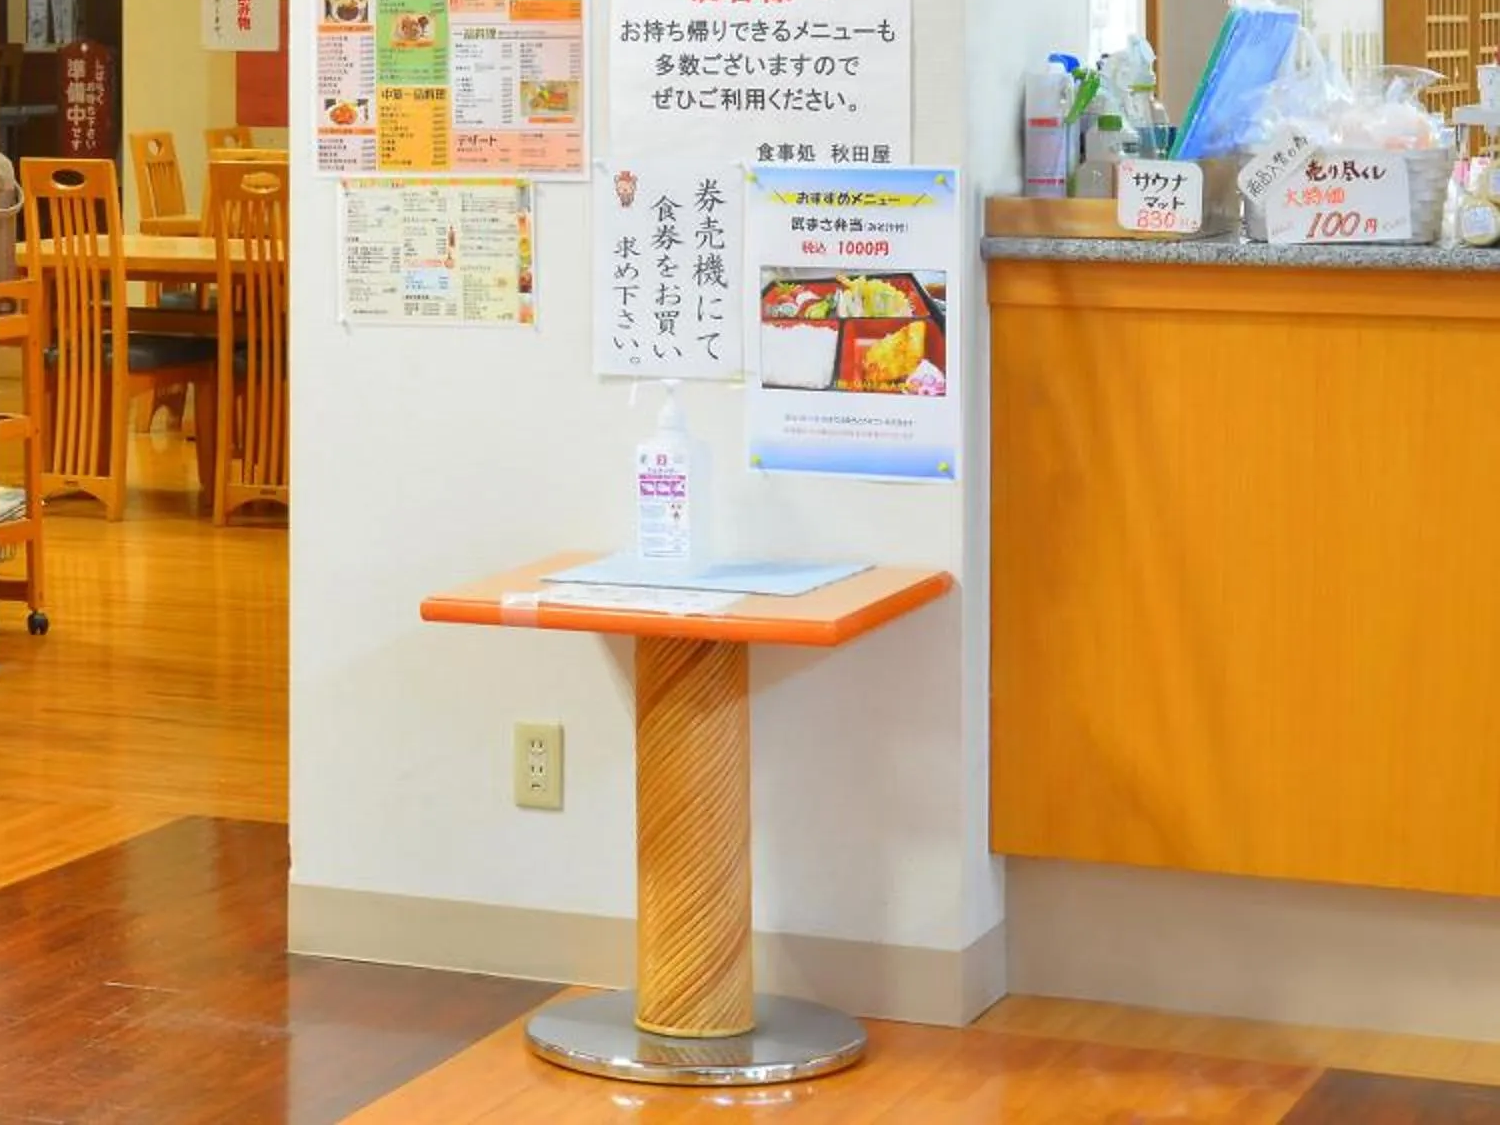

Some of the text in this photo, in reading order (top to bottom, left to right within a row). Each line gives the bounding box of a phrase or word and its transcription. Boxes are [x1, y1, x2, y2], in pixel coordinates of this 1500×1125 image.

[620, 19, 896, 43] お持ち帰りできるメニューも
[655, 53, 860, 76] 多数ございますので
[651, 88, 858, 111] ぜひご利用ください。
[757, 143, 892, 163] 食事処 秋田屋
[1133, 173, 1187, 193] サウナ
[796, 191, 900, 206] おすすめメニュー
[1144, 197, 1184, 210] マット
[838, 240, 889, 256] 1000円
[650, 195, 685, 359] 食券をお買い
[692, 178, 728, 361] 券売機にて
[613, 236, 640, 365] 求め下さい。
